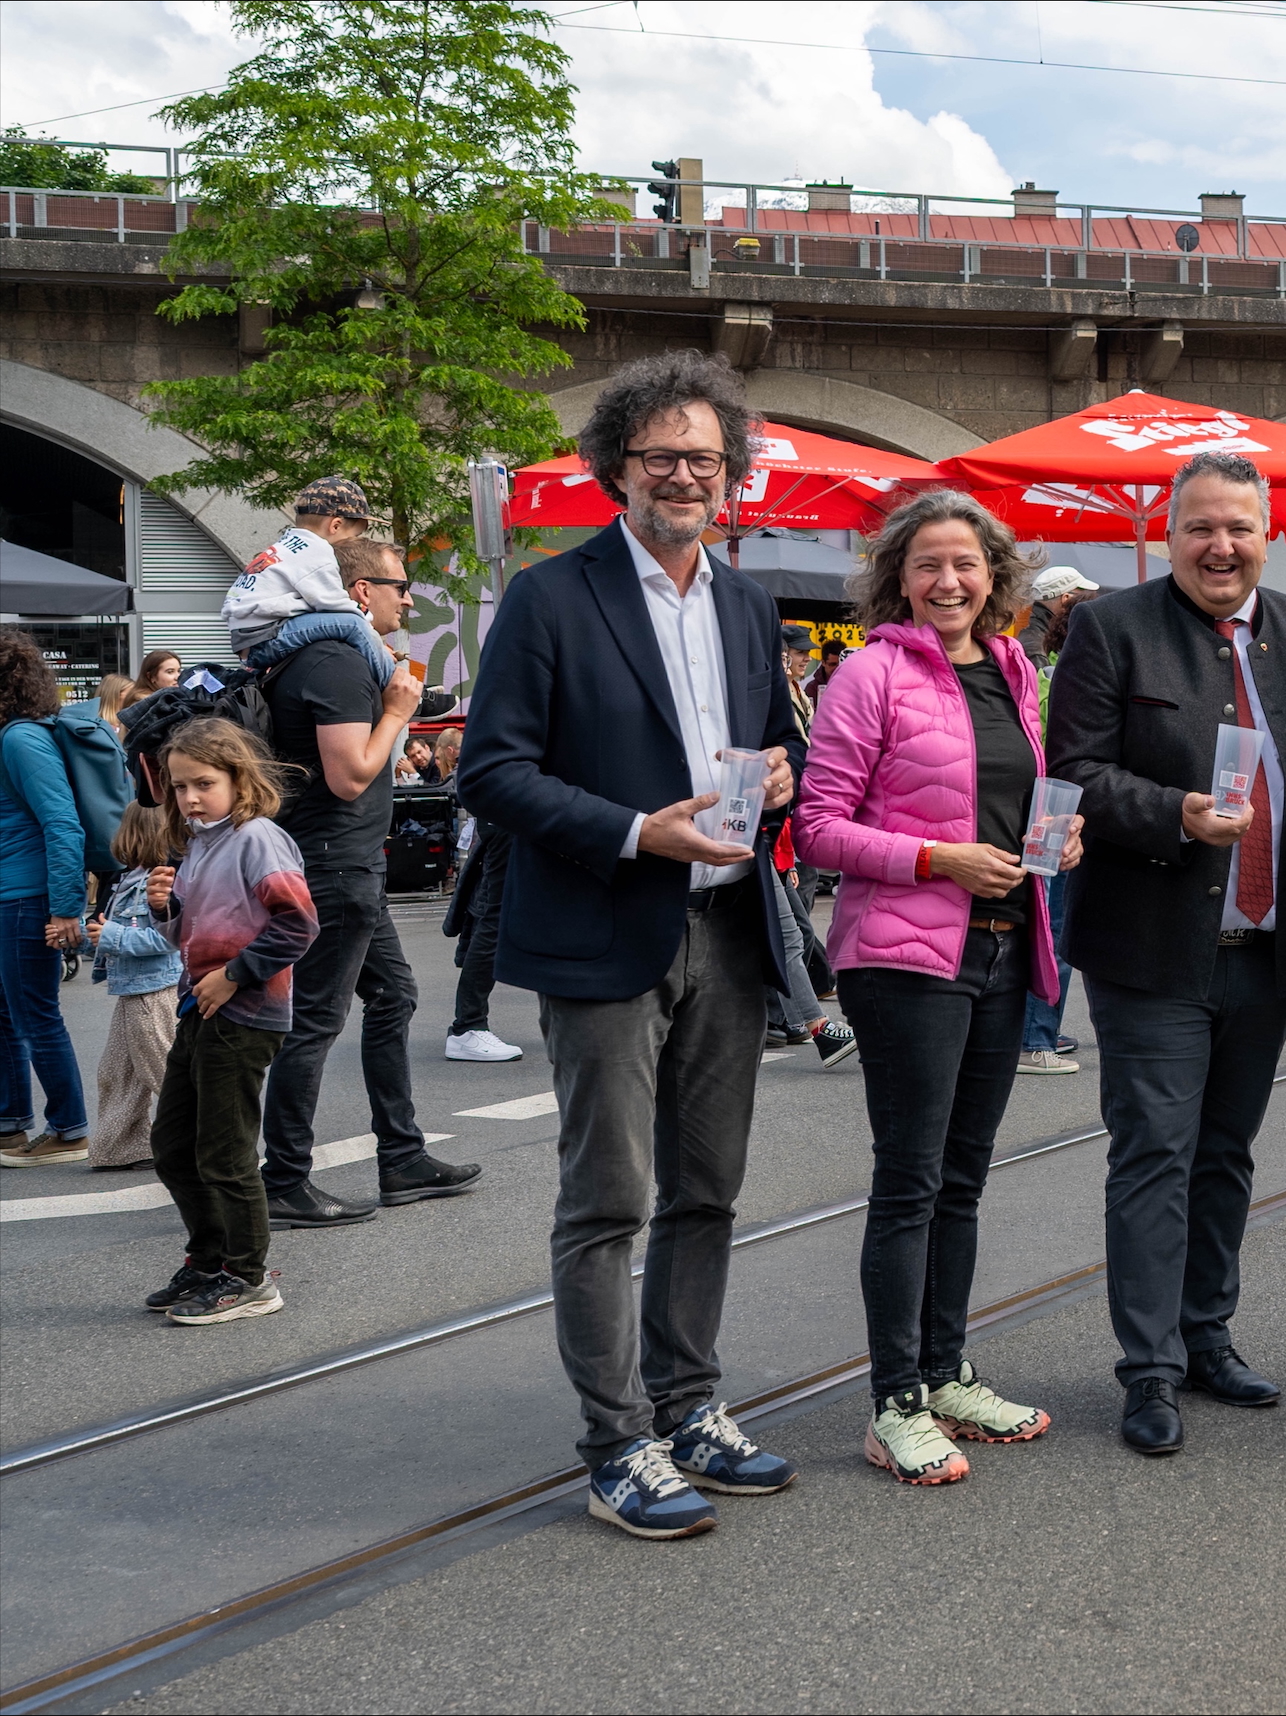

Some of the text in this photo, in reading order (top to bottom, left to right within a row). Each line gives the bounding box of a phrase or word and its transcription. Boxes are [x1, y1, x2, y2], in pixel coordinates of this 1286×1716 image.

[283, 536, 309, 554] THE
[818, 629, 866, 642] 2025
[43, 651, 67, 659] CASA
[65, 690, 88, 698] 0512
